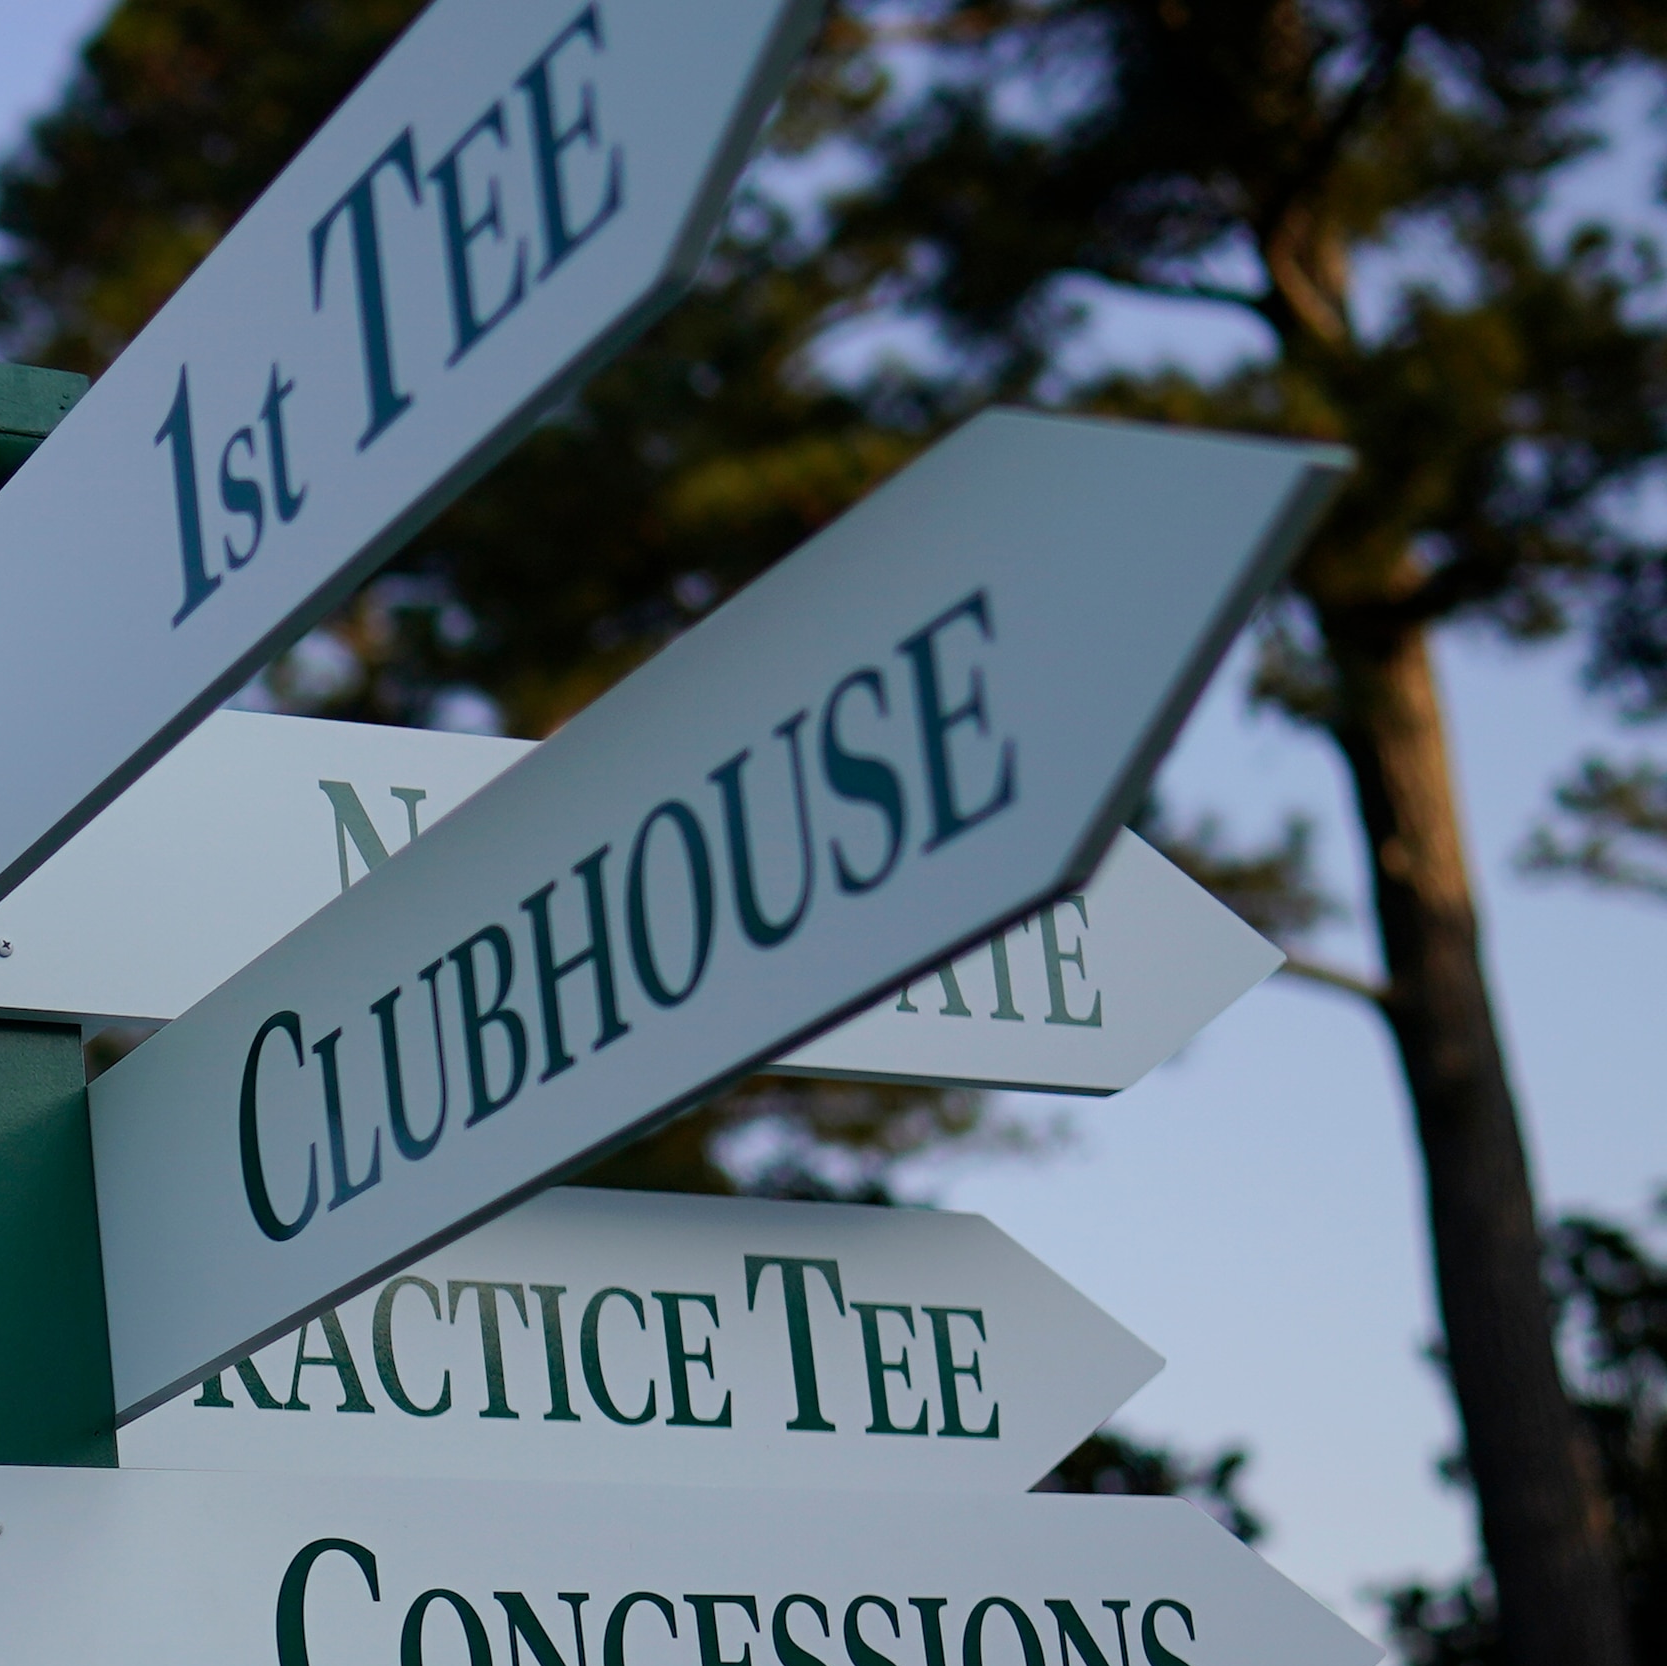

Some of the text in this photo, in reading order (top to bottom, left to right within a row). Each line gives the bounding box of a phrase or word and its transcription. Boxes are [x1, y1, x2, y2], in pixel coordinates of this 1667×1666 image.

[154, 1, 625, 631] 1st TEE
[238, 587, 1018, 1243] CLUBHOUSE
[743, 1253, 1000, 1440] TEE
